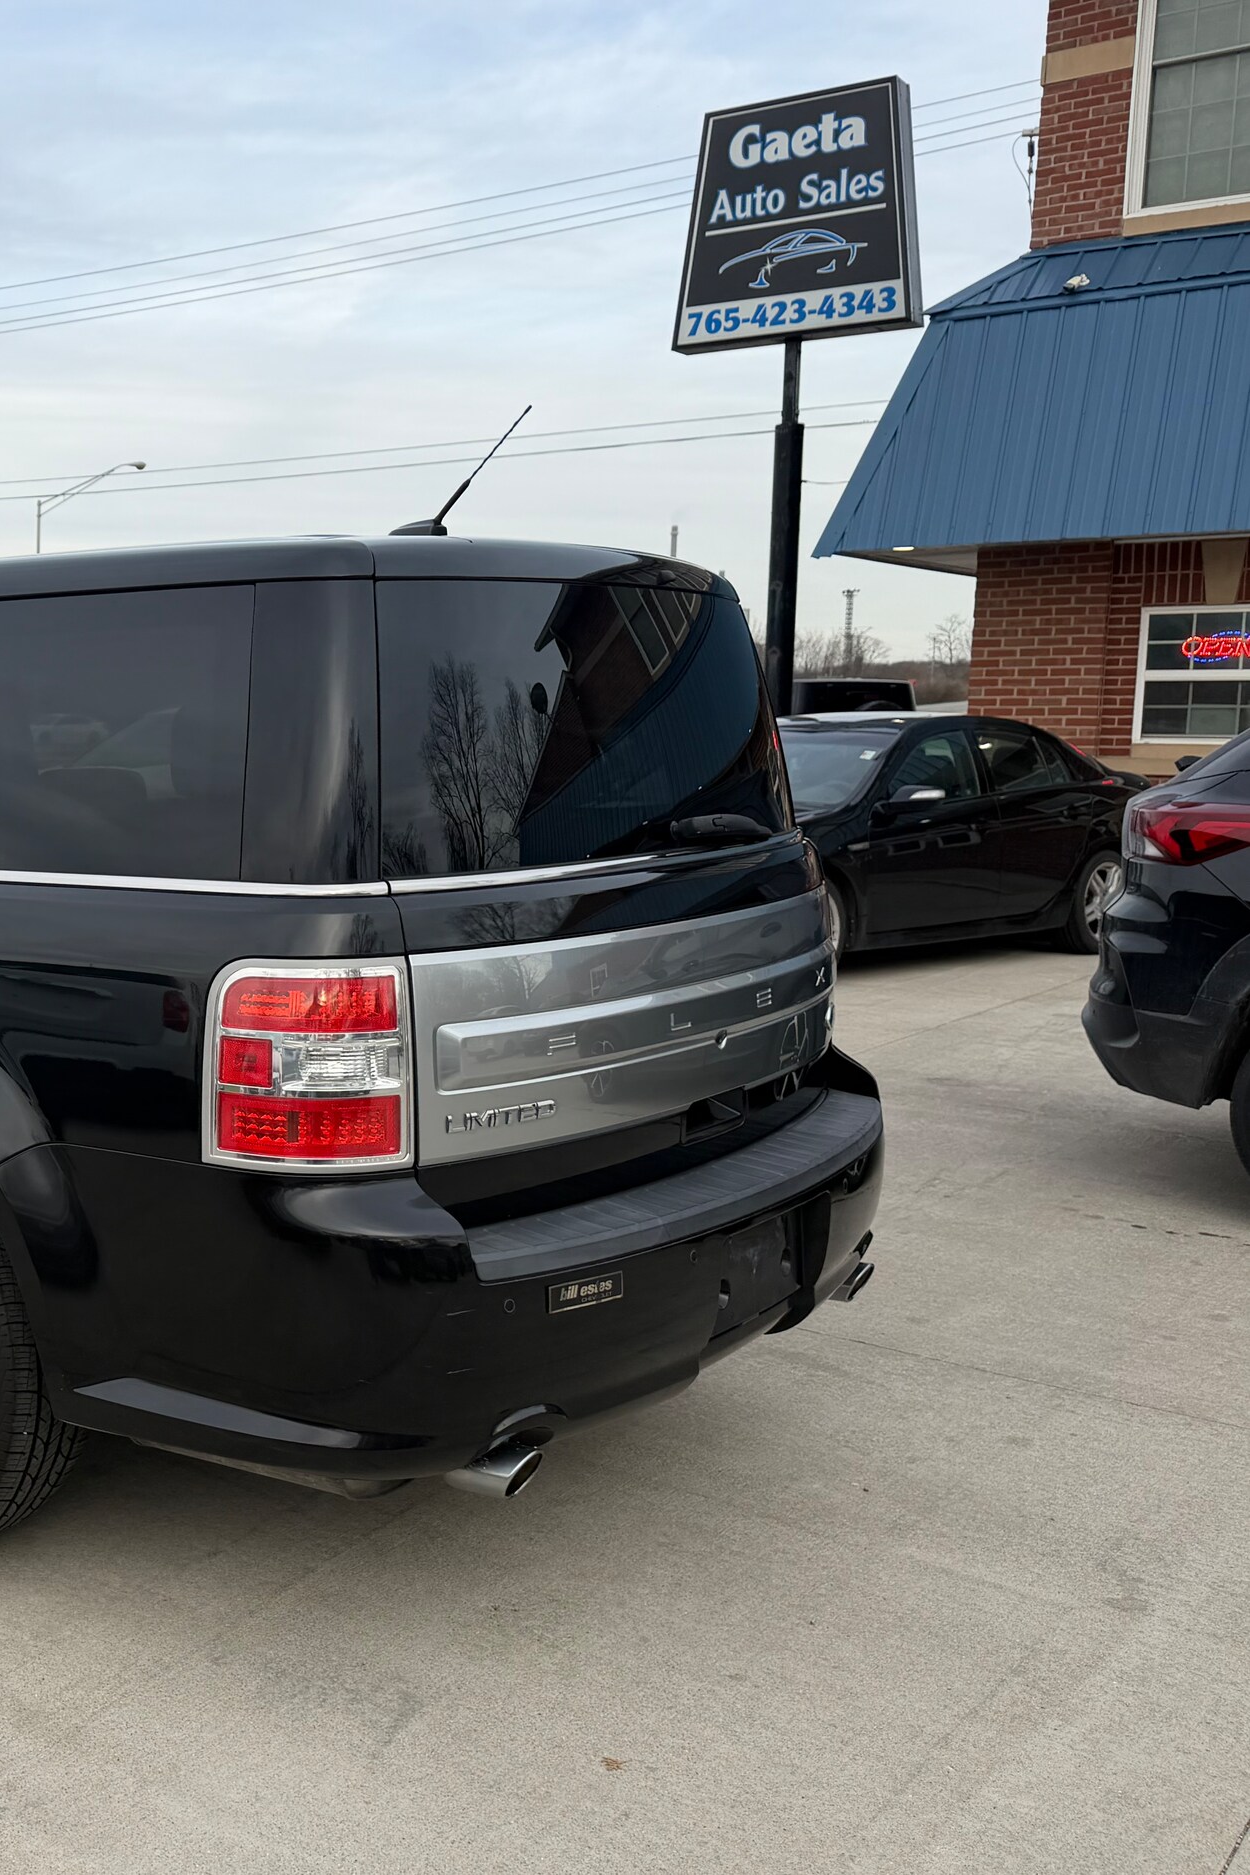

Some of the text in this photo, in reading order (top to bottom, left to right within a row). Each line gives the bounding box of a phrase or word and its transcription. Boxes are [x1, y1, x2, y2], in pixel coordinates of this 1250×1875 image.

[728, 111, 868, 169] Gaeta
[708, 168, 885, 225] Auto Sales
[687, 286, 897, 337] 765-423-4343
[1181, 636, 1250, 658] OPEN
[547, 966, 826, 1056] FLEX
[445, 1099, 556, 1134] LIMITED
[560, 1284, 579, 1301] bill
